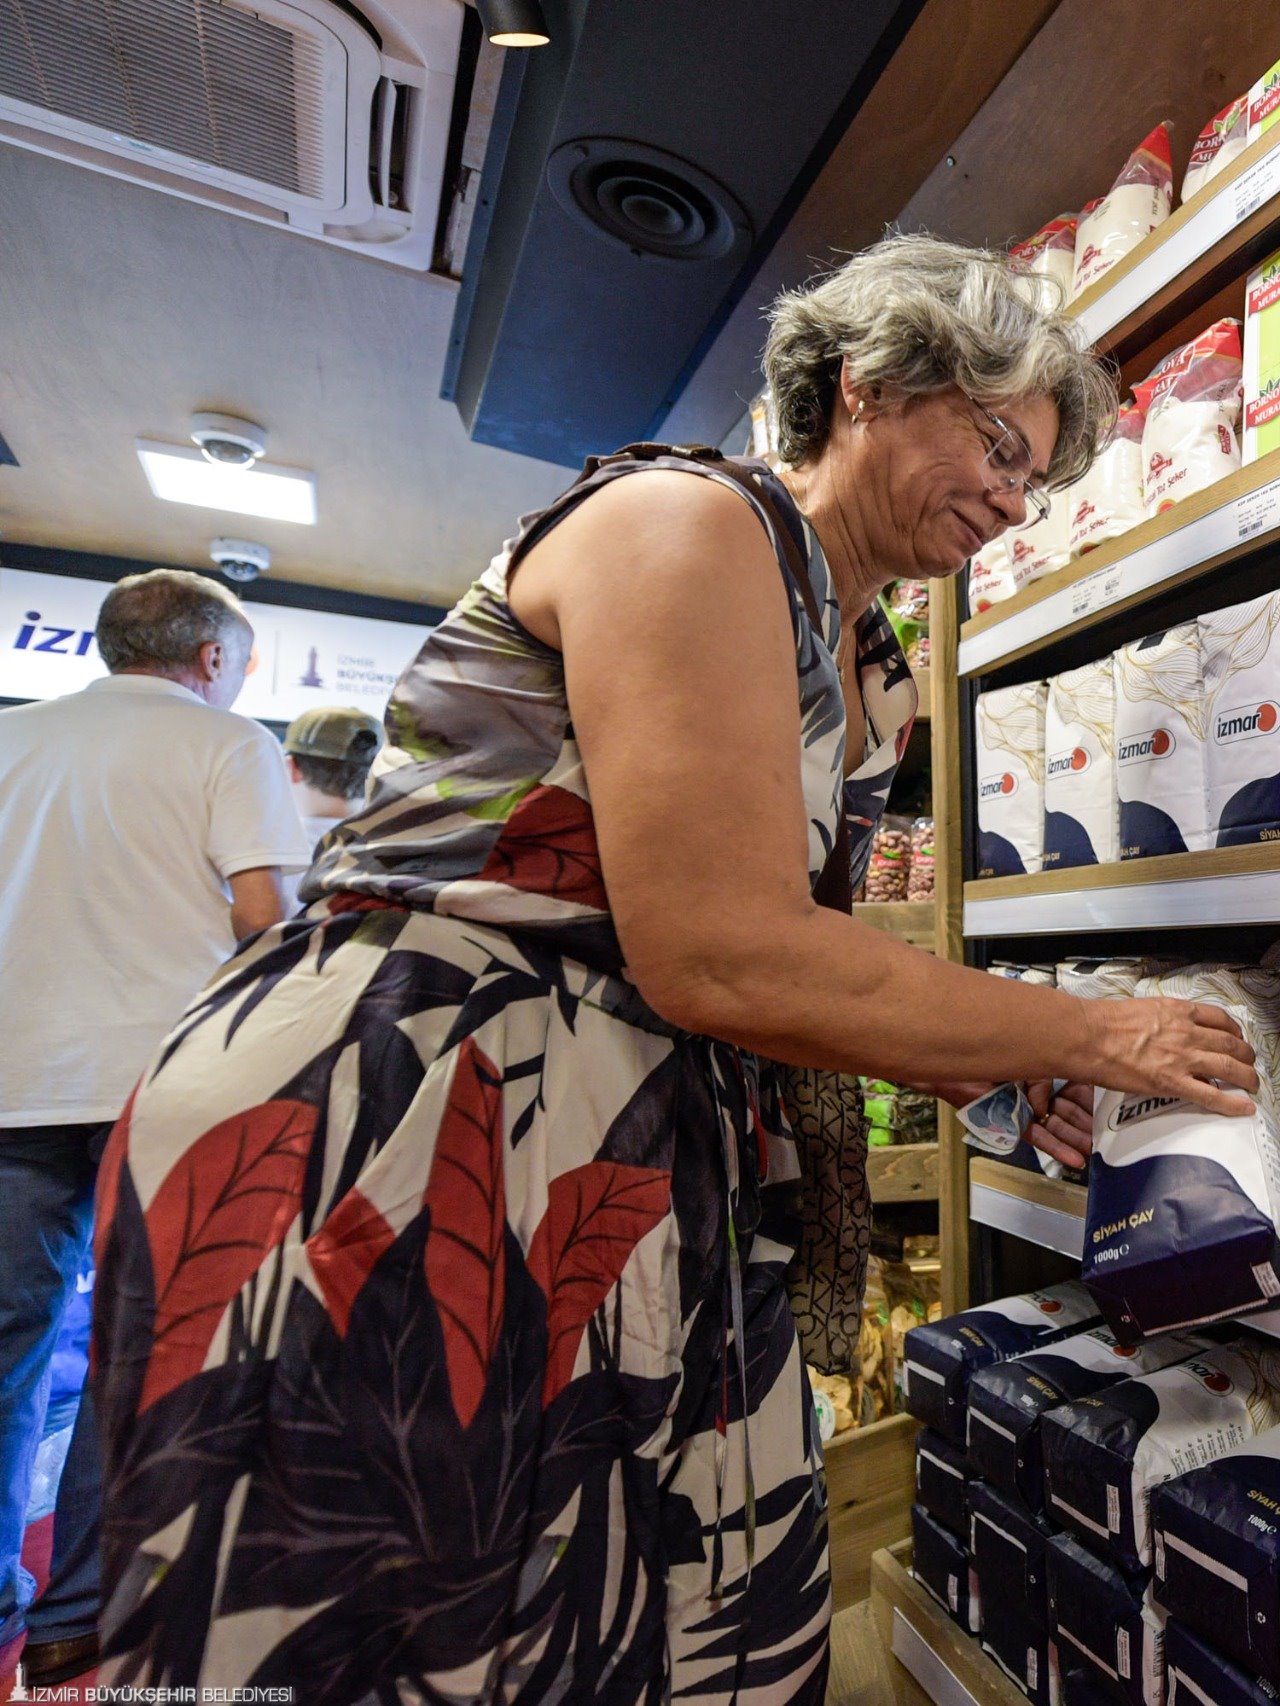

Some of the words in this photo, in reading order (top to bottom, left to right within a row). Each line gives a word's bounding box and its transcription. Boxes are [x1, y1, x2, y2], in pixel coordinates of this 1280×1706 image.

[1217, 714, 1261, 738] izmar
[1119, 738, 1155, 760] izmar
[1048, 755, 1073, 774] izmar
[981, 778, 1004, 796] izmar
[1093, 1217, 1127, 1243] SİYAH
[1129, 1208, 1155, 1229] ÇAY
[1247, 1490, 1278, 1510] SİYAH
